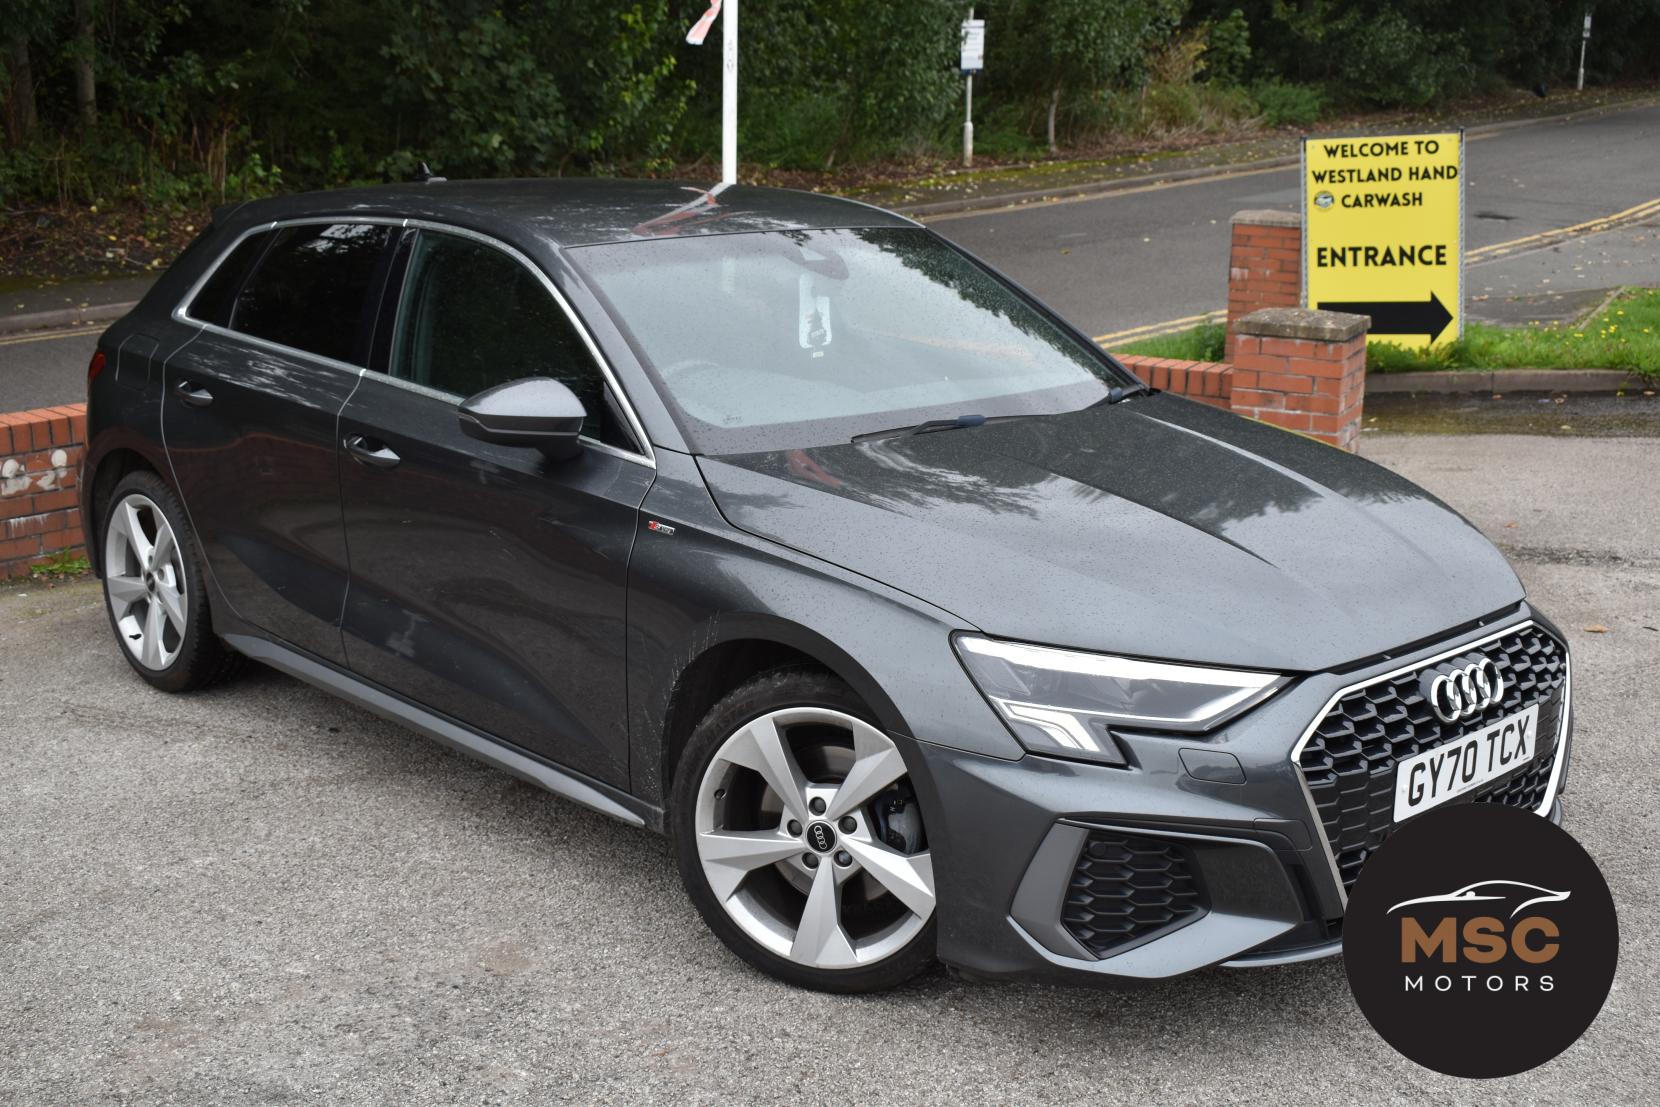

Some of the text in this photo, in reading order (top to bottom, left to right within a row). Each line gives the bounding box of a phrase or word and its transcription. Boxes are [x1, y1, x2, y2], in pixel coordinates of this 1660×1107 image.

[1323, 140, 1440, 158] WELCOME TO
[1312, 165, 1458, 184] WESTLAND HAND
[1341, 192, 1423, 208] CARWASH
[1317, 245, 1447, 267] ENTRANCE
[1408, 715, 1530, 807] GY70 TCX
